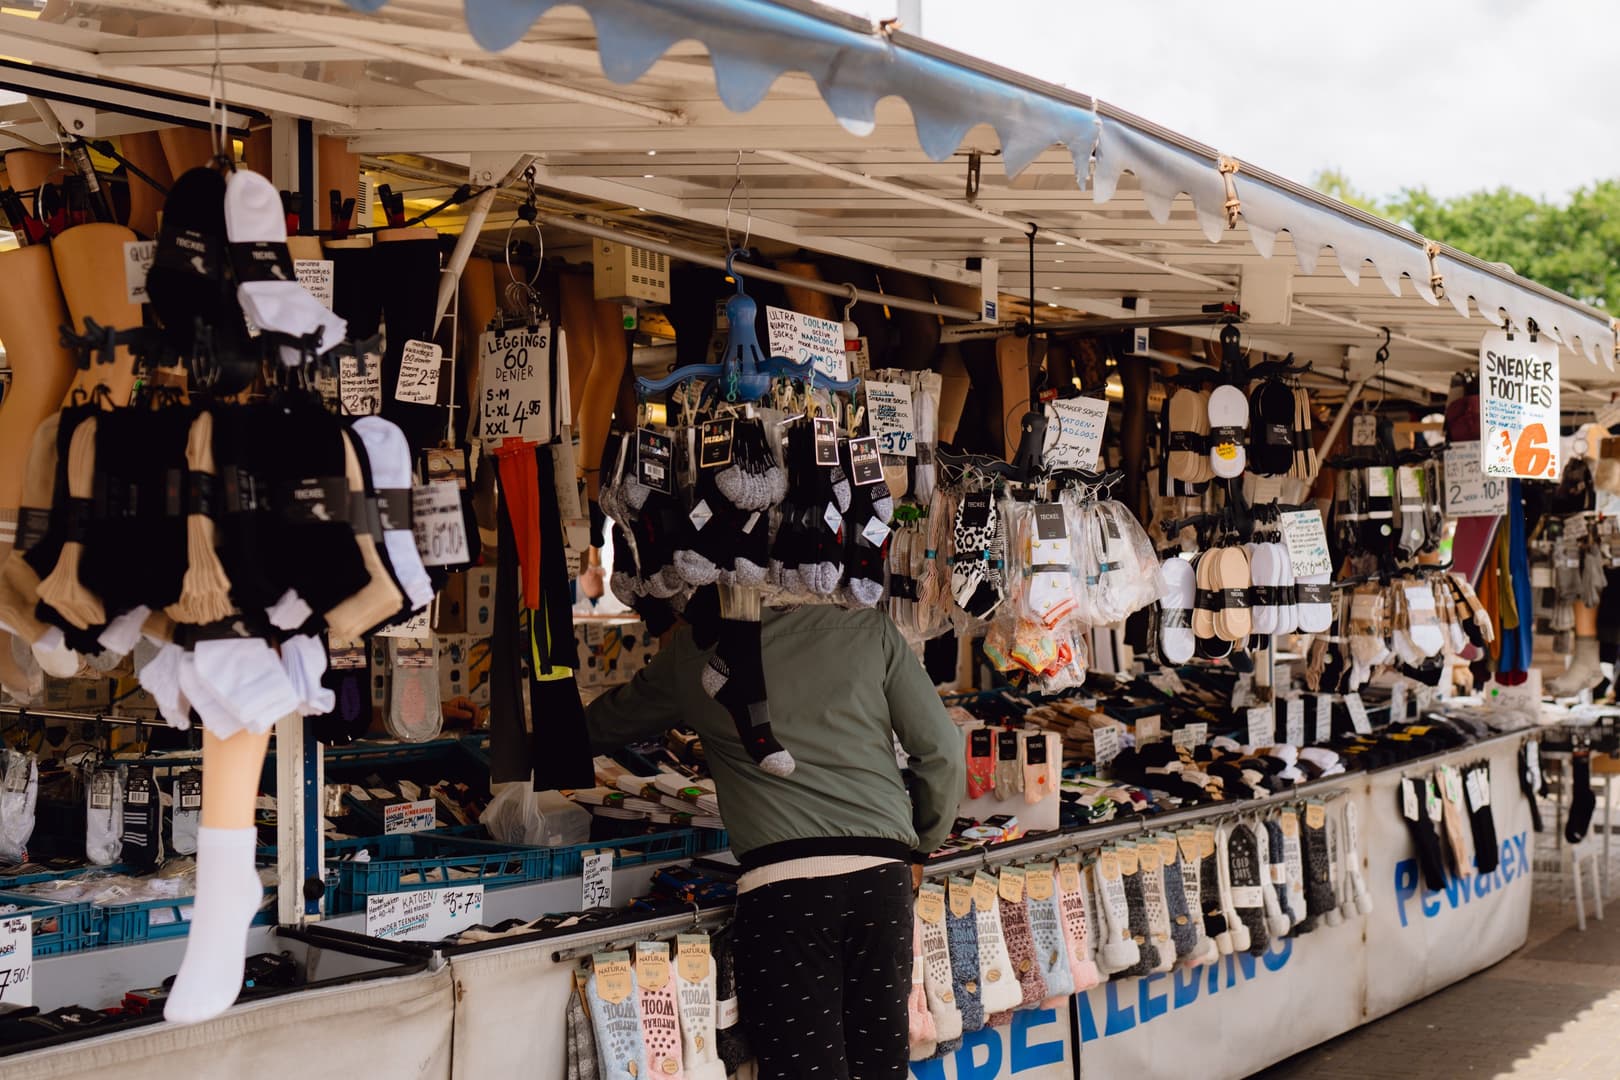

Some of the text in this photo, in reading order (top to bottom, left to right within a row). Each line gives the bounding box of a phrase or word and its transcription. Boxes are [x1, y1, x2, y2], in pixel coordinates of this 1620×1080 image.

[769, 310, 796, 322] ULTRA
[769, 321, 798, 333] QUARTER
[773, 330, 794, 341] SOCKS
[403, 353, 415, 364] 60
[504, 348, 529, 370] 60
[1486, 350, 1554, 383] SNEAKER
[1488, 375, 1553, 409] FOOTIES
[1052, 402, 1082, 413] SNEAKER
[485, 419, 509, 436] XXL
[1500, 429, 1513, 456] 3
[1449, 484, 1463, 505] 2
[1232, 856, 1250, 869] COLD
[1233, 867, 1252, 880] DAYS
[1063, 897, 1084, 912] WOOL
[1030, 908, 1056, 922] WOOL
[977, 922, 999, 935] WOO
[923, 935, 946, 953] WOOL
[680, 946, 707, 956] NATURAL
[640, 954, 666, 963] NATURAL
[598, 965, 627, 975] NATURAL
[681, 989, 711, 1005] WOOL
[603, 1002, 637, 1021] WOOL
[641, 998, 675, 1017] WOOL
[643, 1017, 676, 1030] NATURAL
